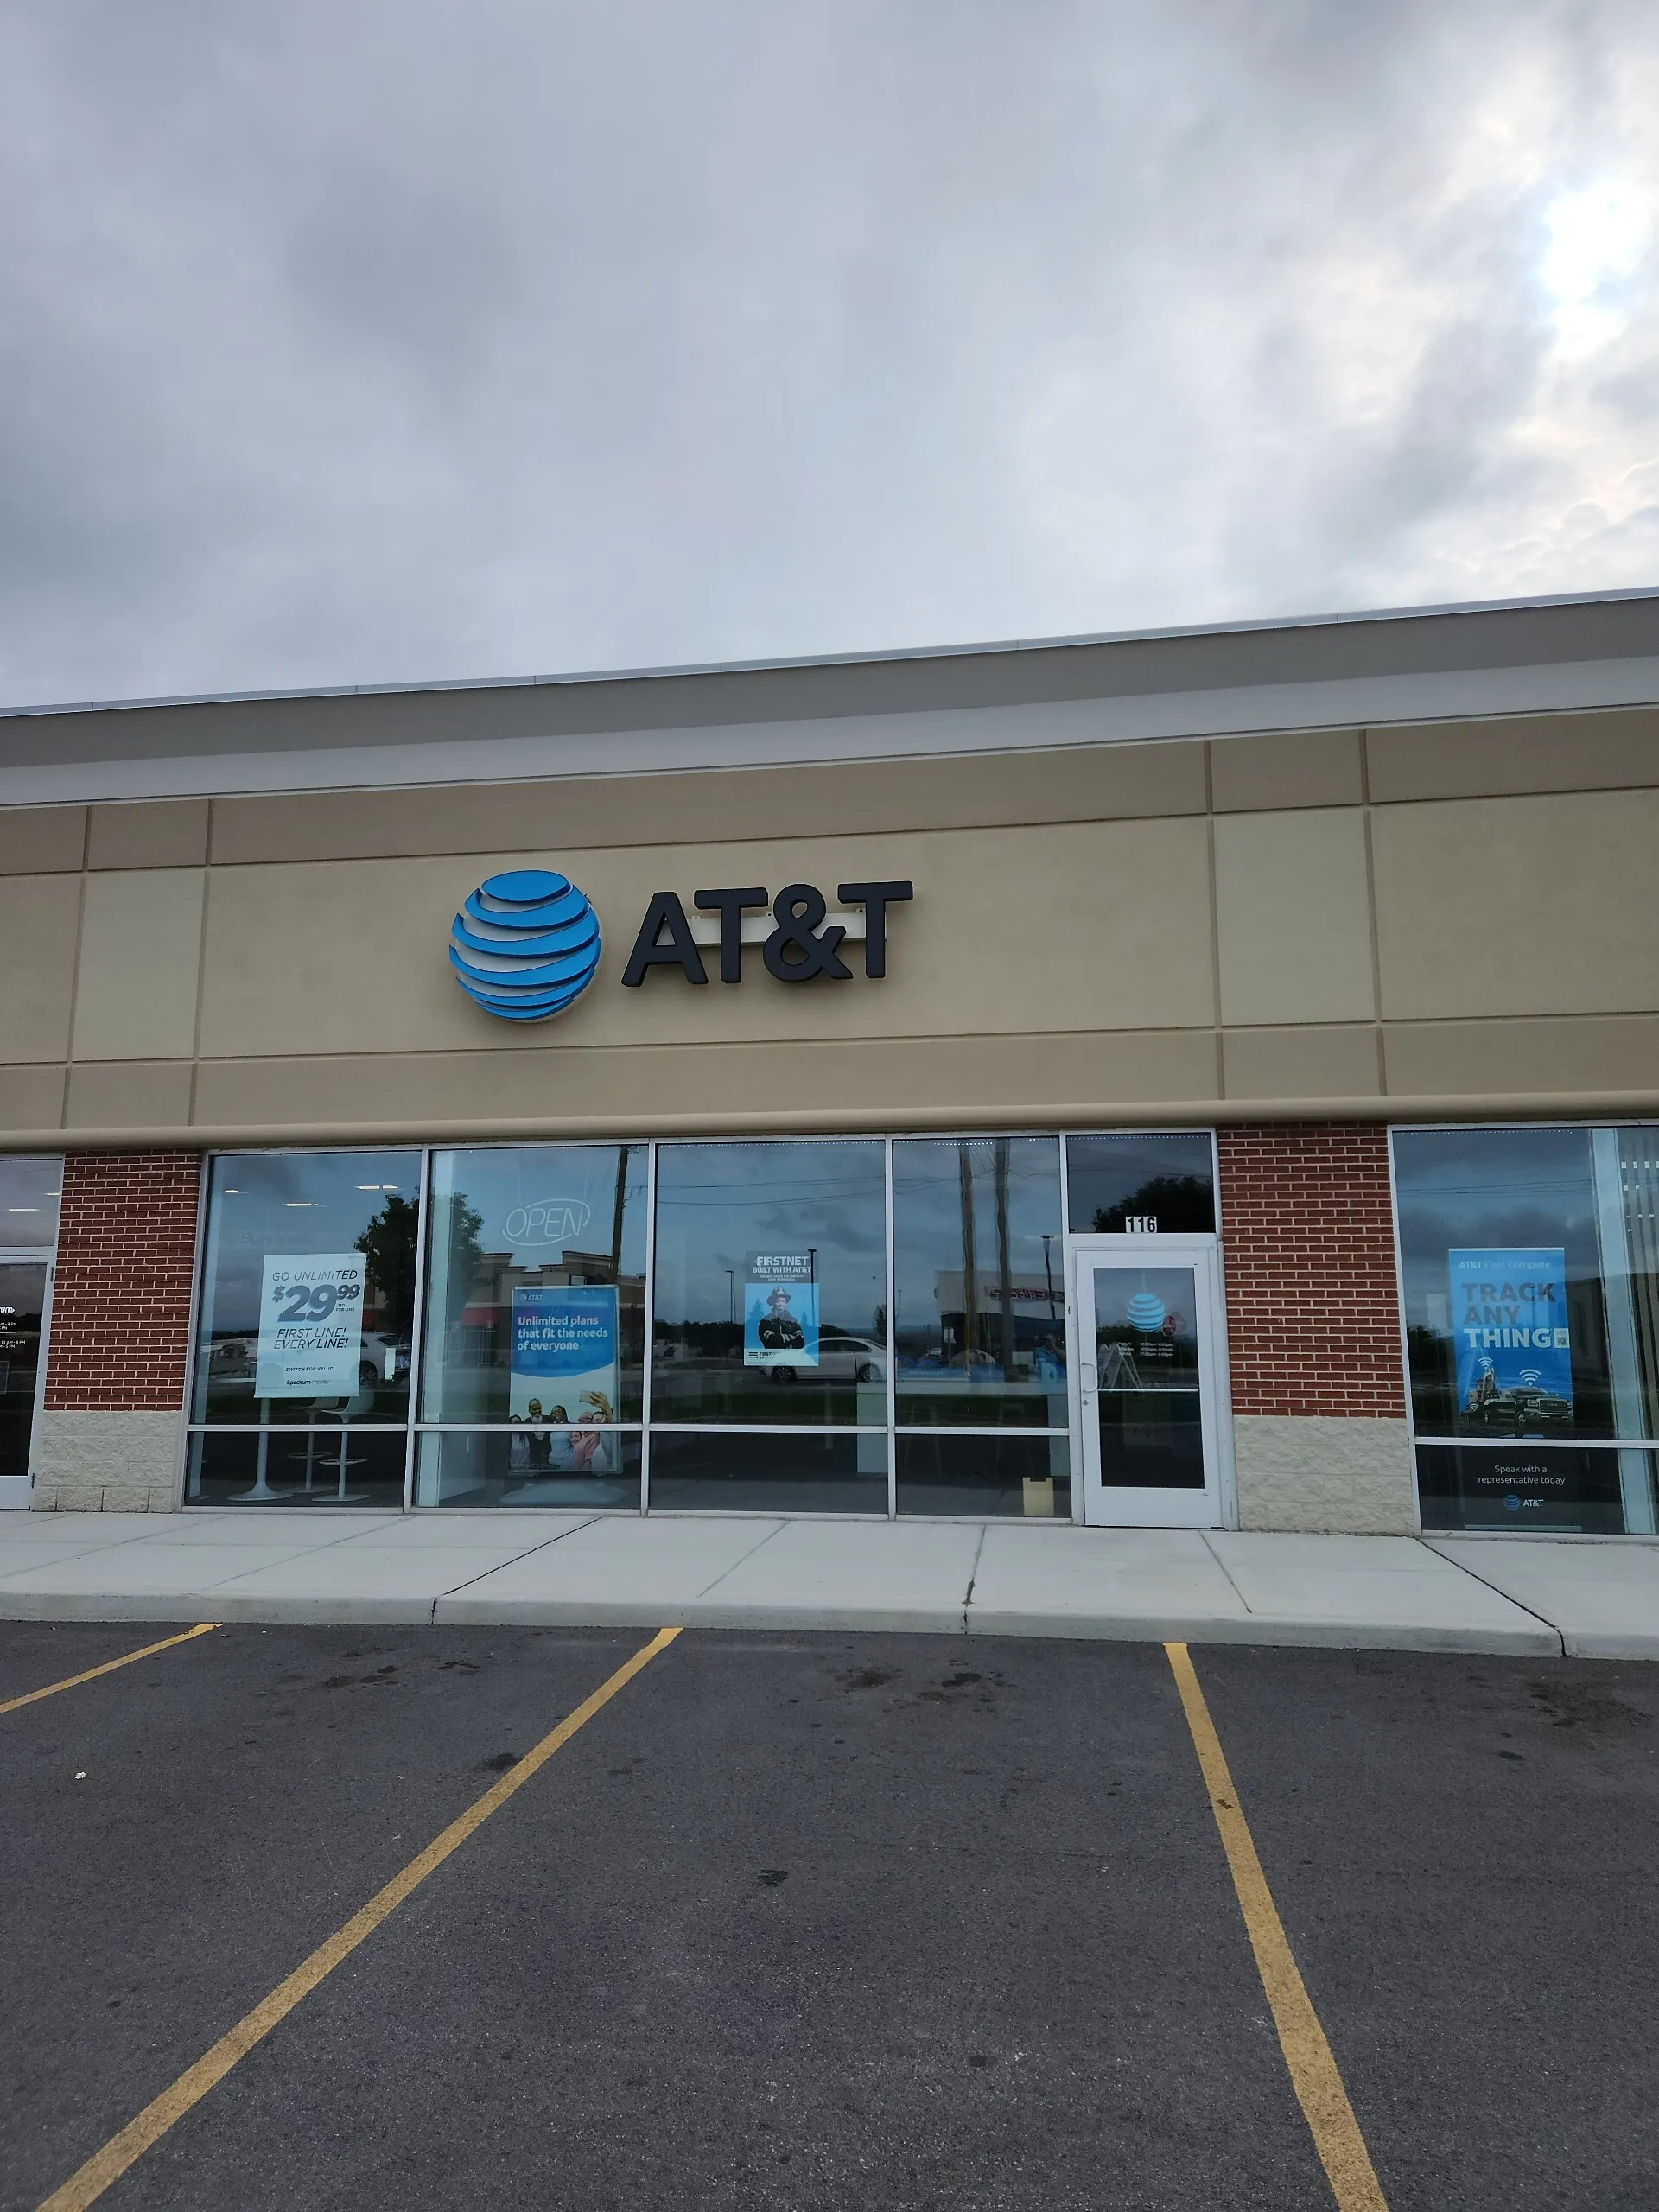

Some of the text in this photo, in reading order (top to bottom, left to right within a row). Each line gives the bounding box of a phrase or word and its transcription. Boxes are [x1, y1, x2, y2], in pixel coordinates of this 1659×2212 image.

[621, 880, 914, 988] AT&T
[506, 1207, 584, 1237] OPEN
[1128, 1217, 1156, 1233] 116
[756, 1255, 810, 1266] FIRSTNET
[272, 1270, 358, 1281] GO UNLIMITED
[1461, 1282, 1555, 1302] TRACK
[518, 1315, 599, 1327] Unlimited plans
[1463, 1306, 1521, 1325] ANY
[276, 1327, 347, 1338] FIRST LINE!
[518, 1327, 608, 1338] that fit the needs
[274, 1338, 349, 1349] EVERY LINE!
[518, 1341, 579, 1352] of everyone
[1494, 1465, 1521, 1474] Speak
[1522, 1465, 1541, 1473] with
[1478, 1476, 1566, 1486] representative today
